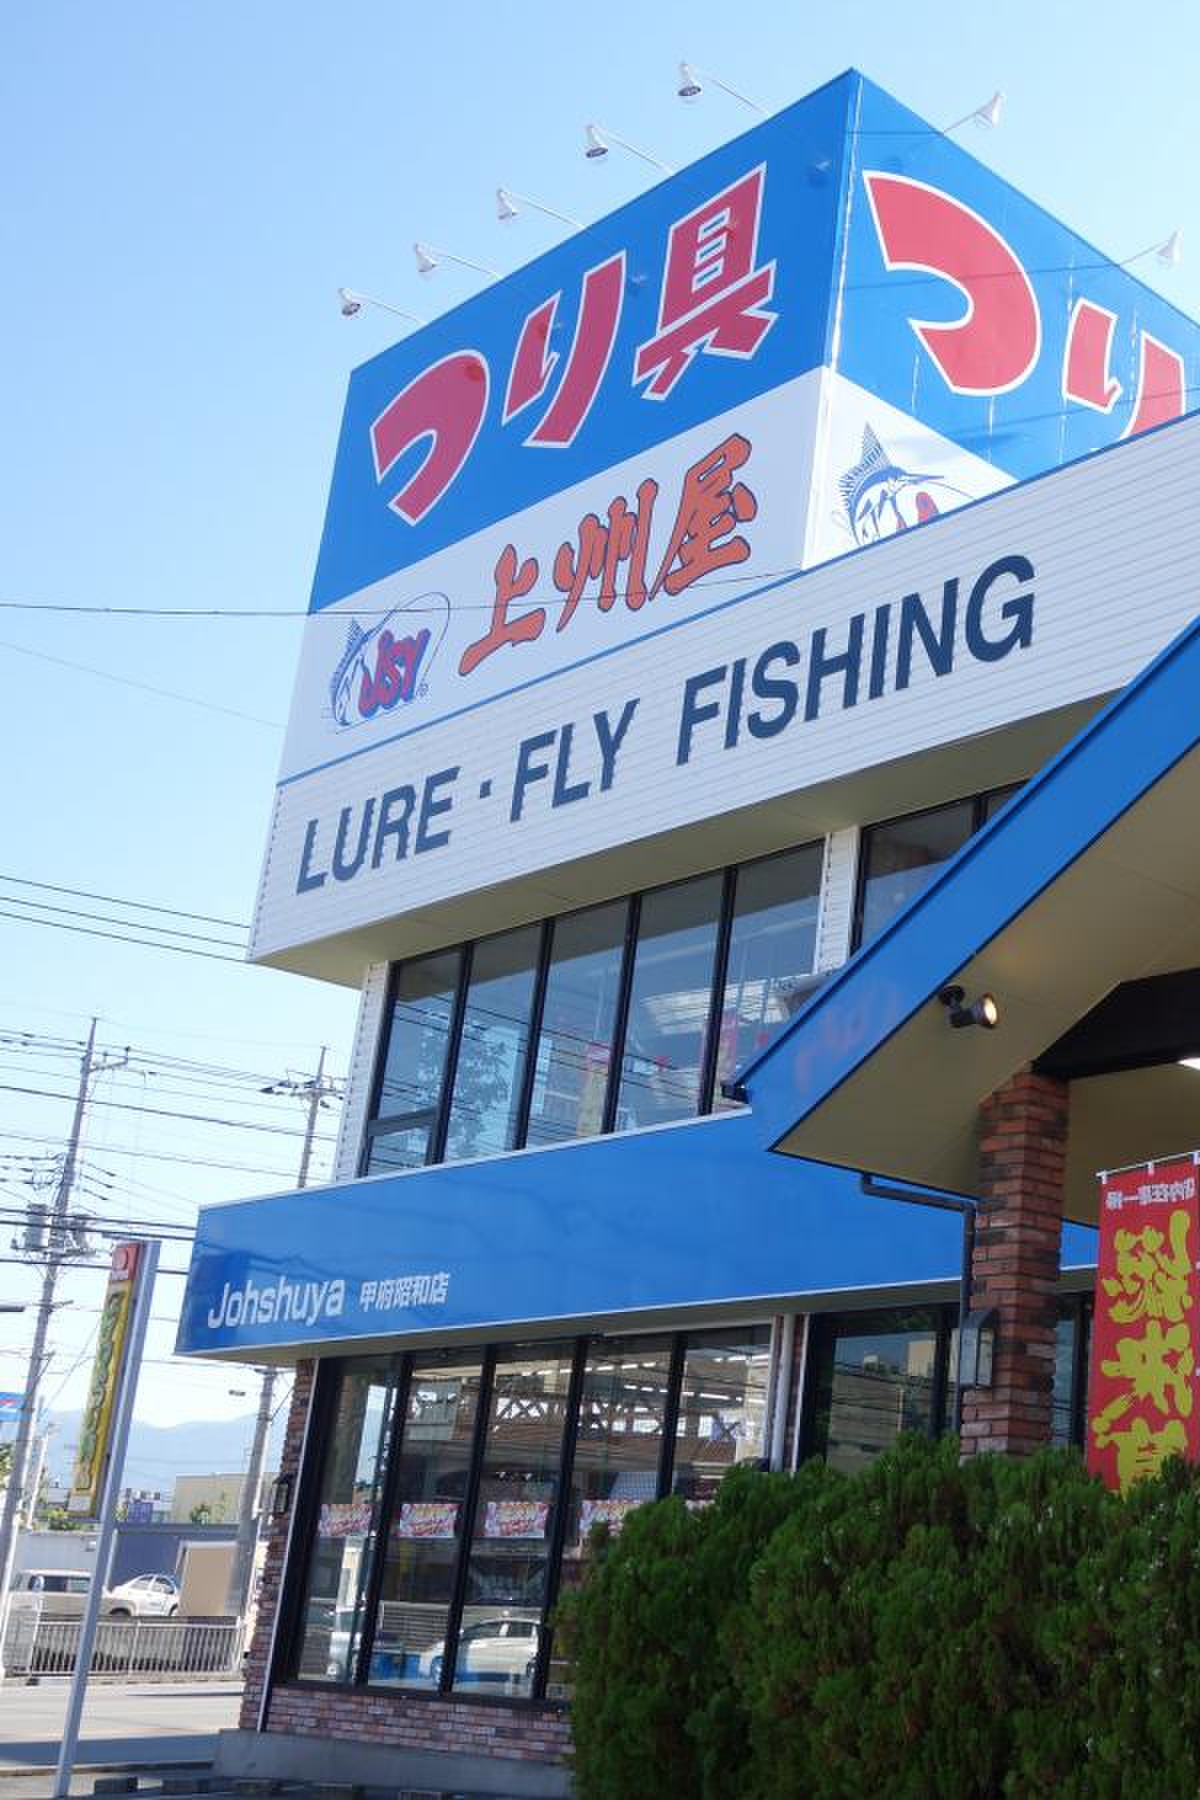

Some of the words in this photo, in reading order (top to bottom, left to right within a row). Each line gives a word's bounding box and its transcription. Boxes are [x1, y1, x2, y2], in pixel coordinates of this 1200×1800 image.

[369, 161, 778, 527] つり具
[458, 432, 758, 676] 上州屋
[295, 765, 460, 895] LURE
[509, 698, 640, 823] FLY
[676, 553, 1036, 766] FISHING
[207, 1275, 346, 1328] Johshuya
[359, 1272, 451, 1312] 甲府昭和店
